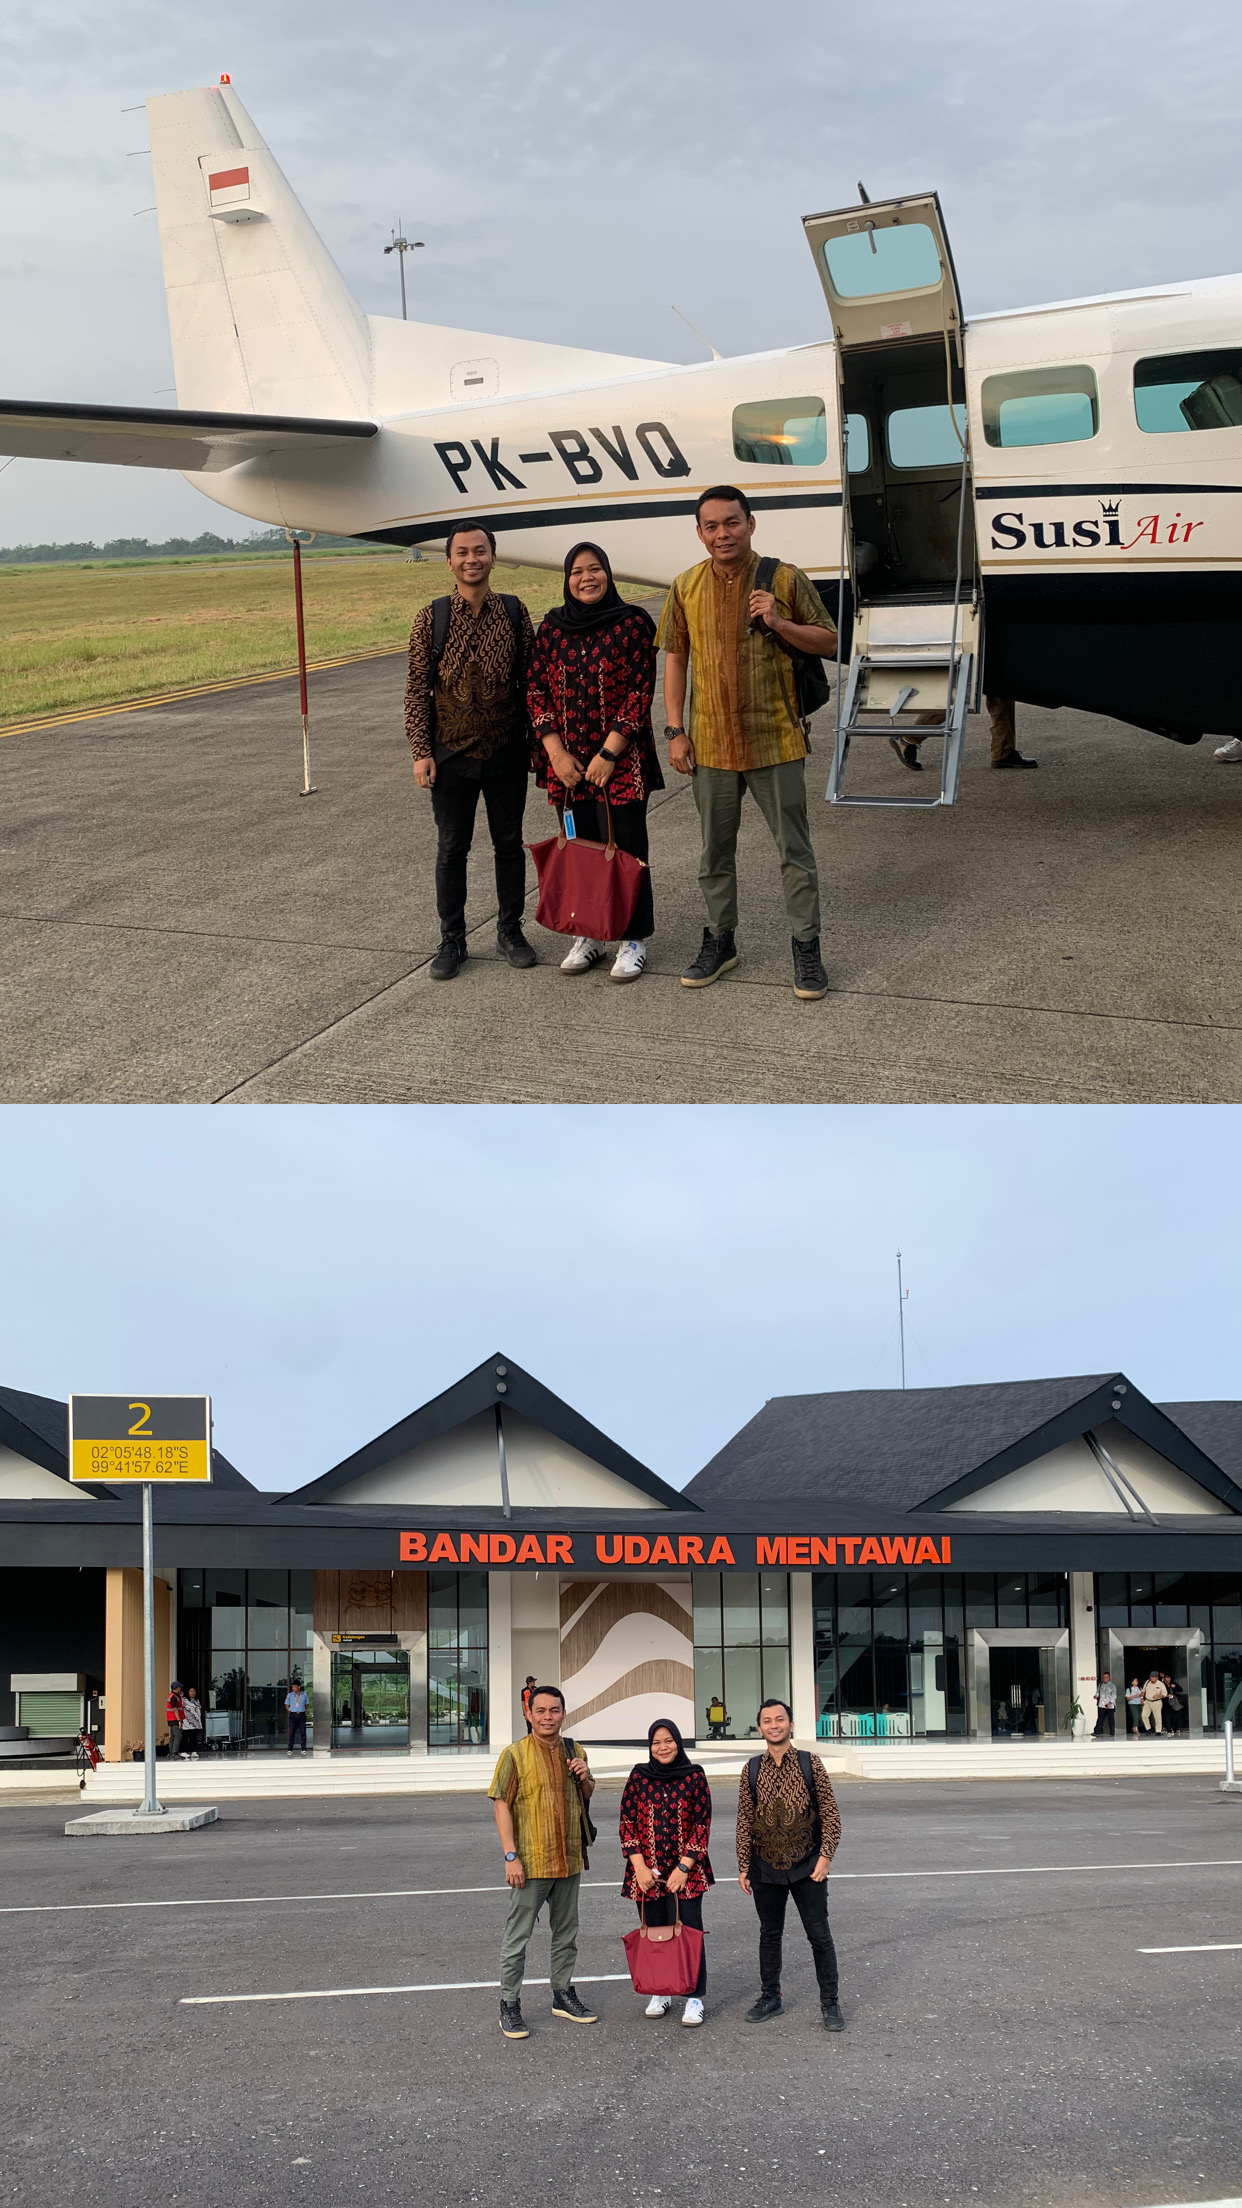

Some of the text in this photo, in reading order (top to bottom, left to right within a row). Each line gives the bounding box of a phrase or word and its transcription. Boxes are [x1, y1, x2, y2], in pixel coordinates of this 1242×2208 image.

[432, 421, 692, 494] PK-BVQ
[991, 512, 1205, 550] Susi Air
[127, 1402, 153, 1436] 2
[91, 1446, 189, 1459] 02°05'48.18"S
[91, 1460, 189, 1474] 99°41'57.62"E
[400, 1531, 952, 1565] BANDAR UDARA MENTAWAI
